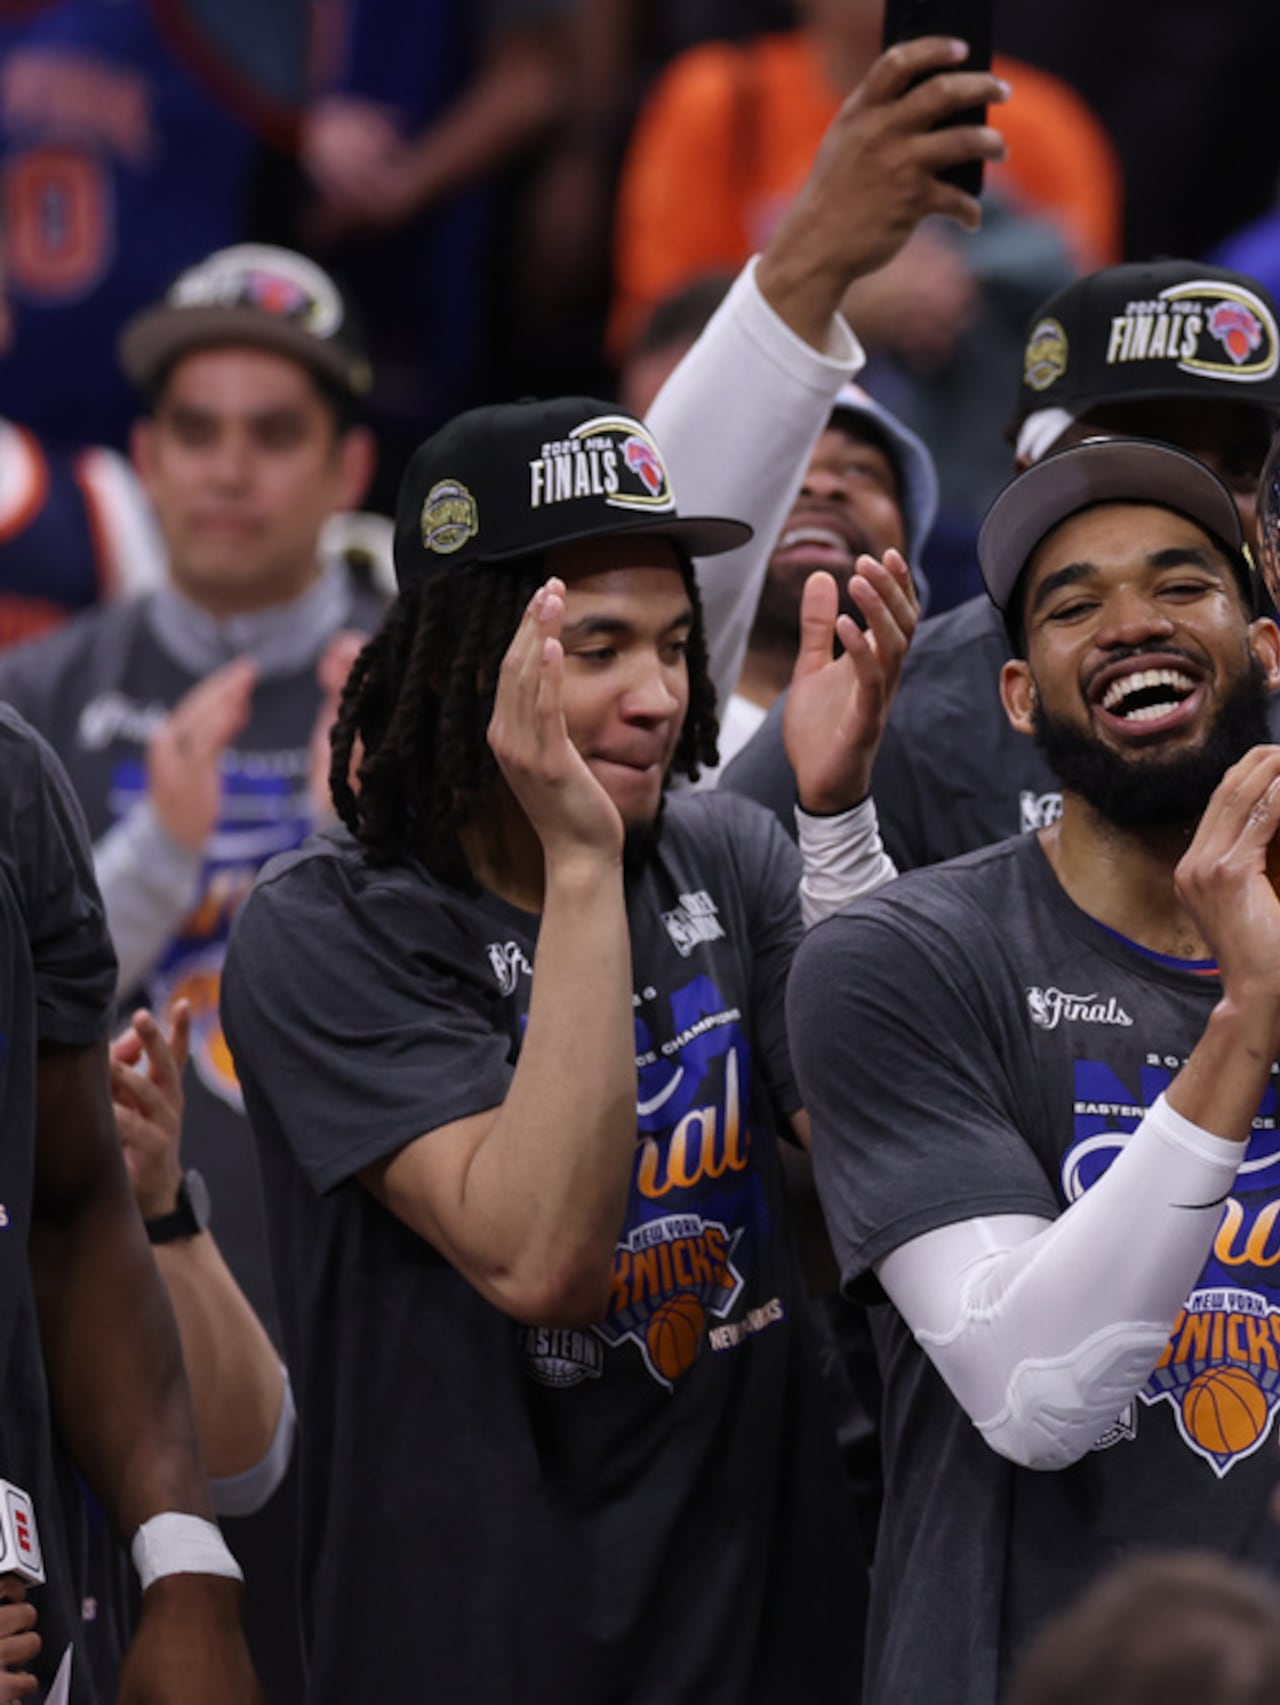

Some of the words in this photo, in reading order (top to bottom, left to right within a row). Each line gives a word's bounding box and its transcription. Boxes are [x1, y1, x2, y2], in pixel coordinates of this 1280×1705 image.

[1106, 313, 1203, 364] FINALS
[584, 436, 615, 450] NBA
[530, 450, 619, 508] FINALS
[1044, 986, 1134, 1030] Finals
[1192, 1291, 1228, 1311] NEW
[1228, 1292, 1267, 1316] YORK
